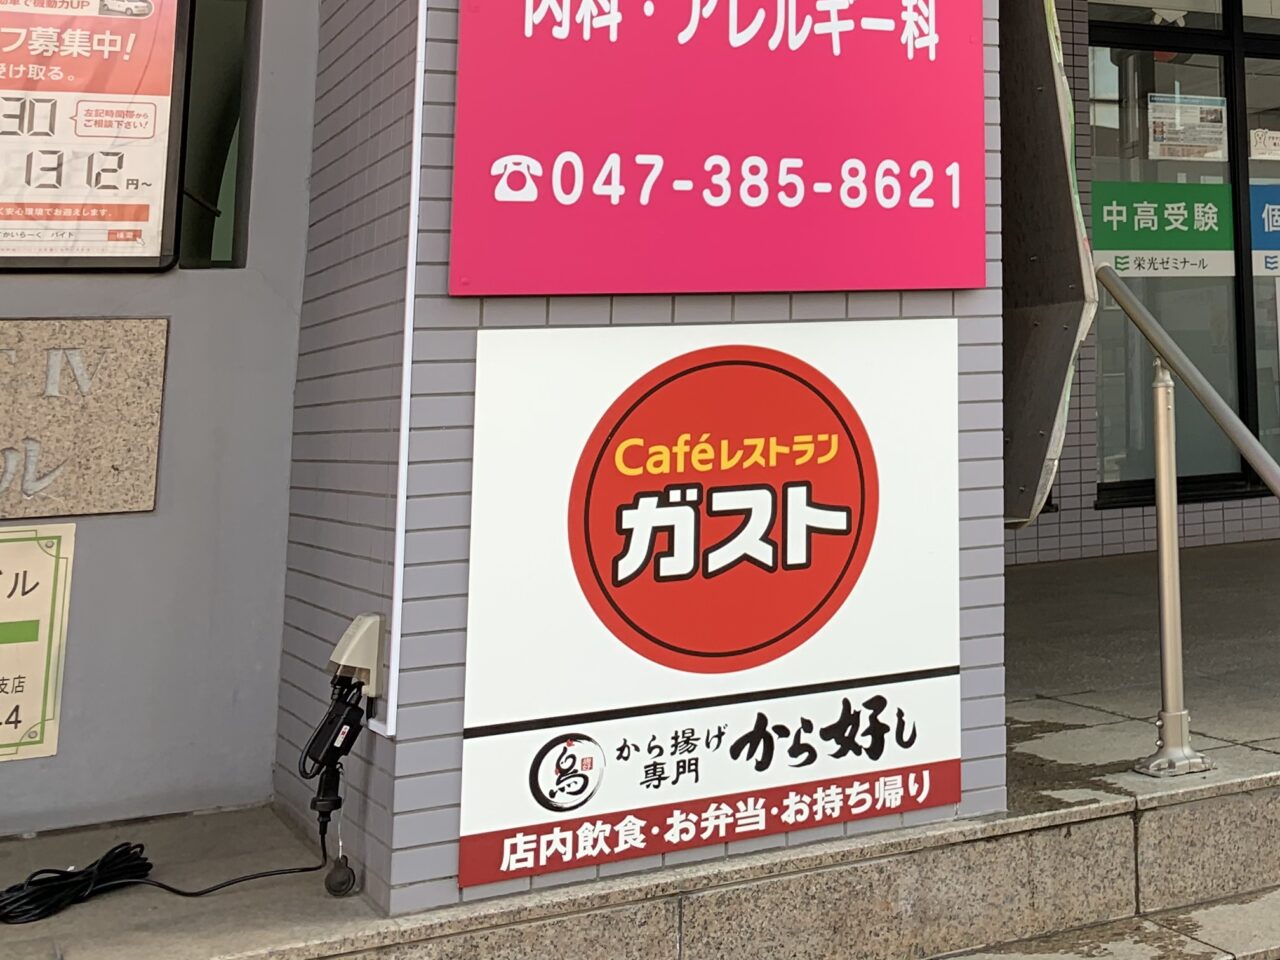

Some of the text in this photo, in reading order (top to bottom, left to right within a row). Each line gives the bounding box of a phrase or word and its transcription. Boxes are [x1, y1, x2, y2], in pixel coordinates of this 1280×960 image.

[552, 151, 961, 209] 047-385-8621
[1102, 200, 1219, 232] 中高受験
[1133, 256, 1208, 271] 栄光ゼミナール
[612, 480, 852, 588] ガスト
[615, 694, 918, 773] から揚げ から好し
[639, 756, 700, 790] 専門
[499, 768, 932, 872] 店内飲食・お弁当・お持ち帰り
